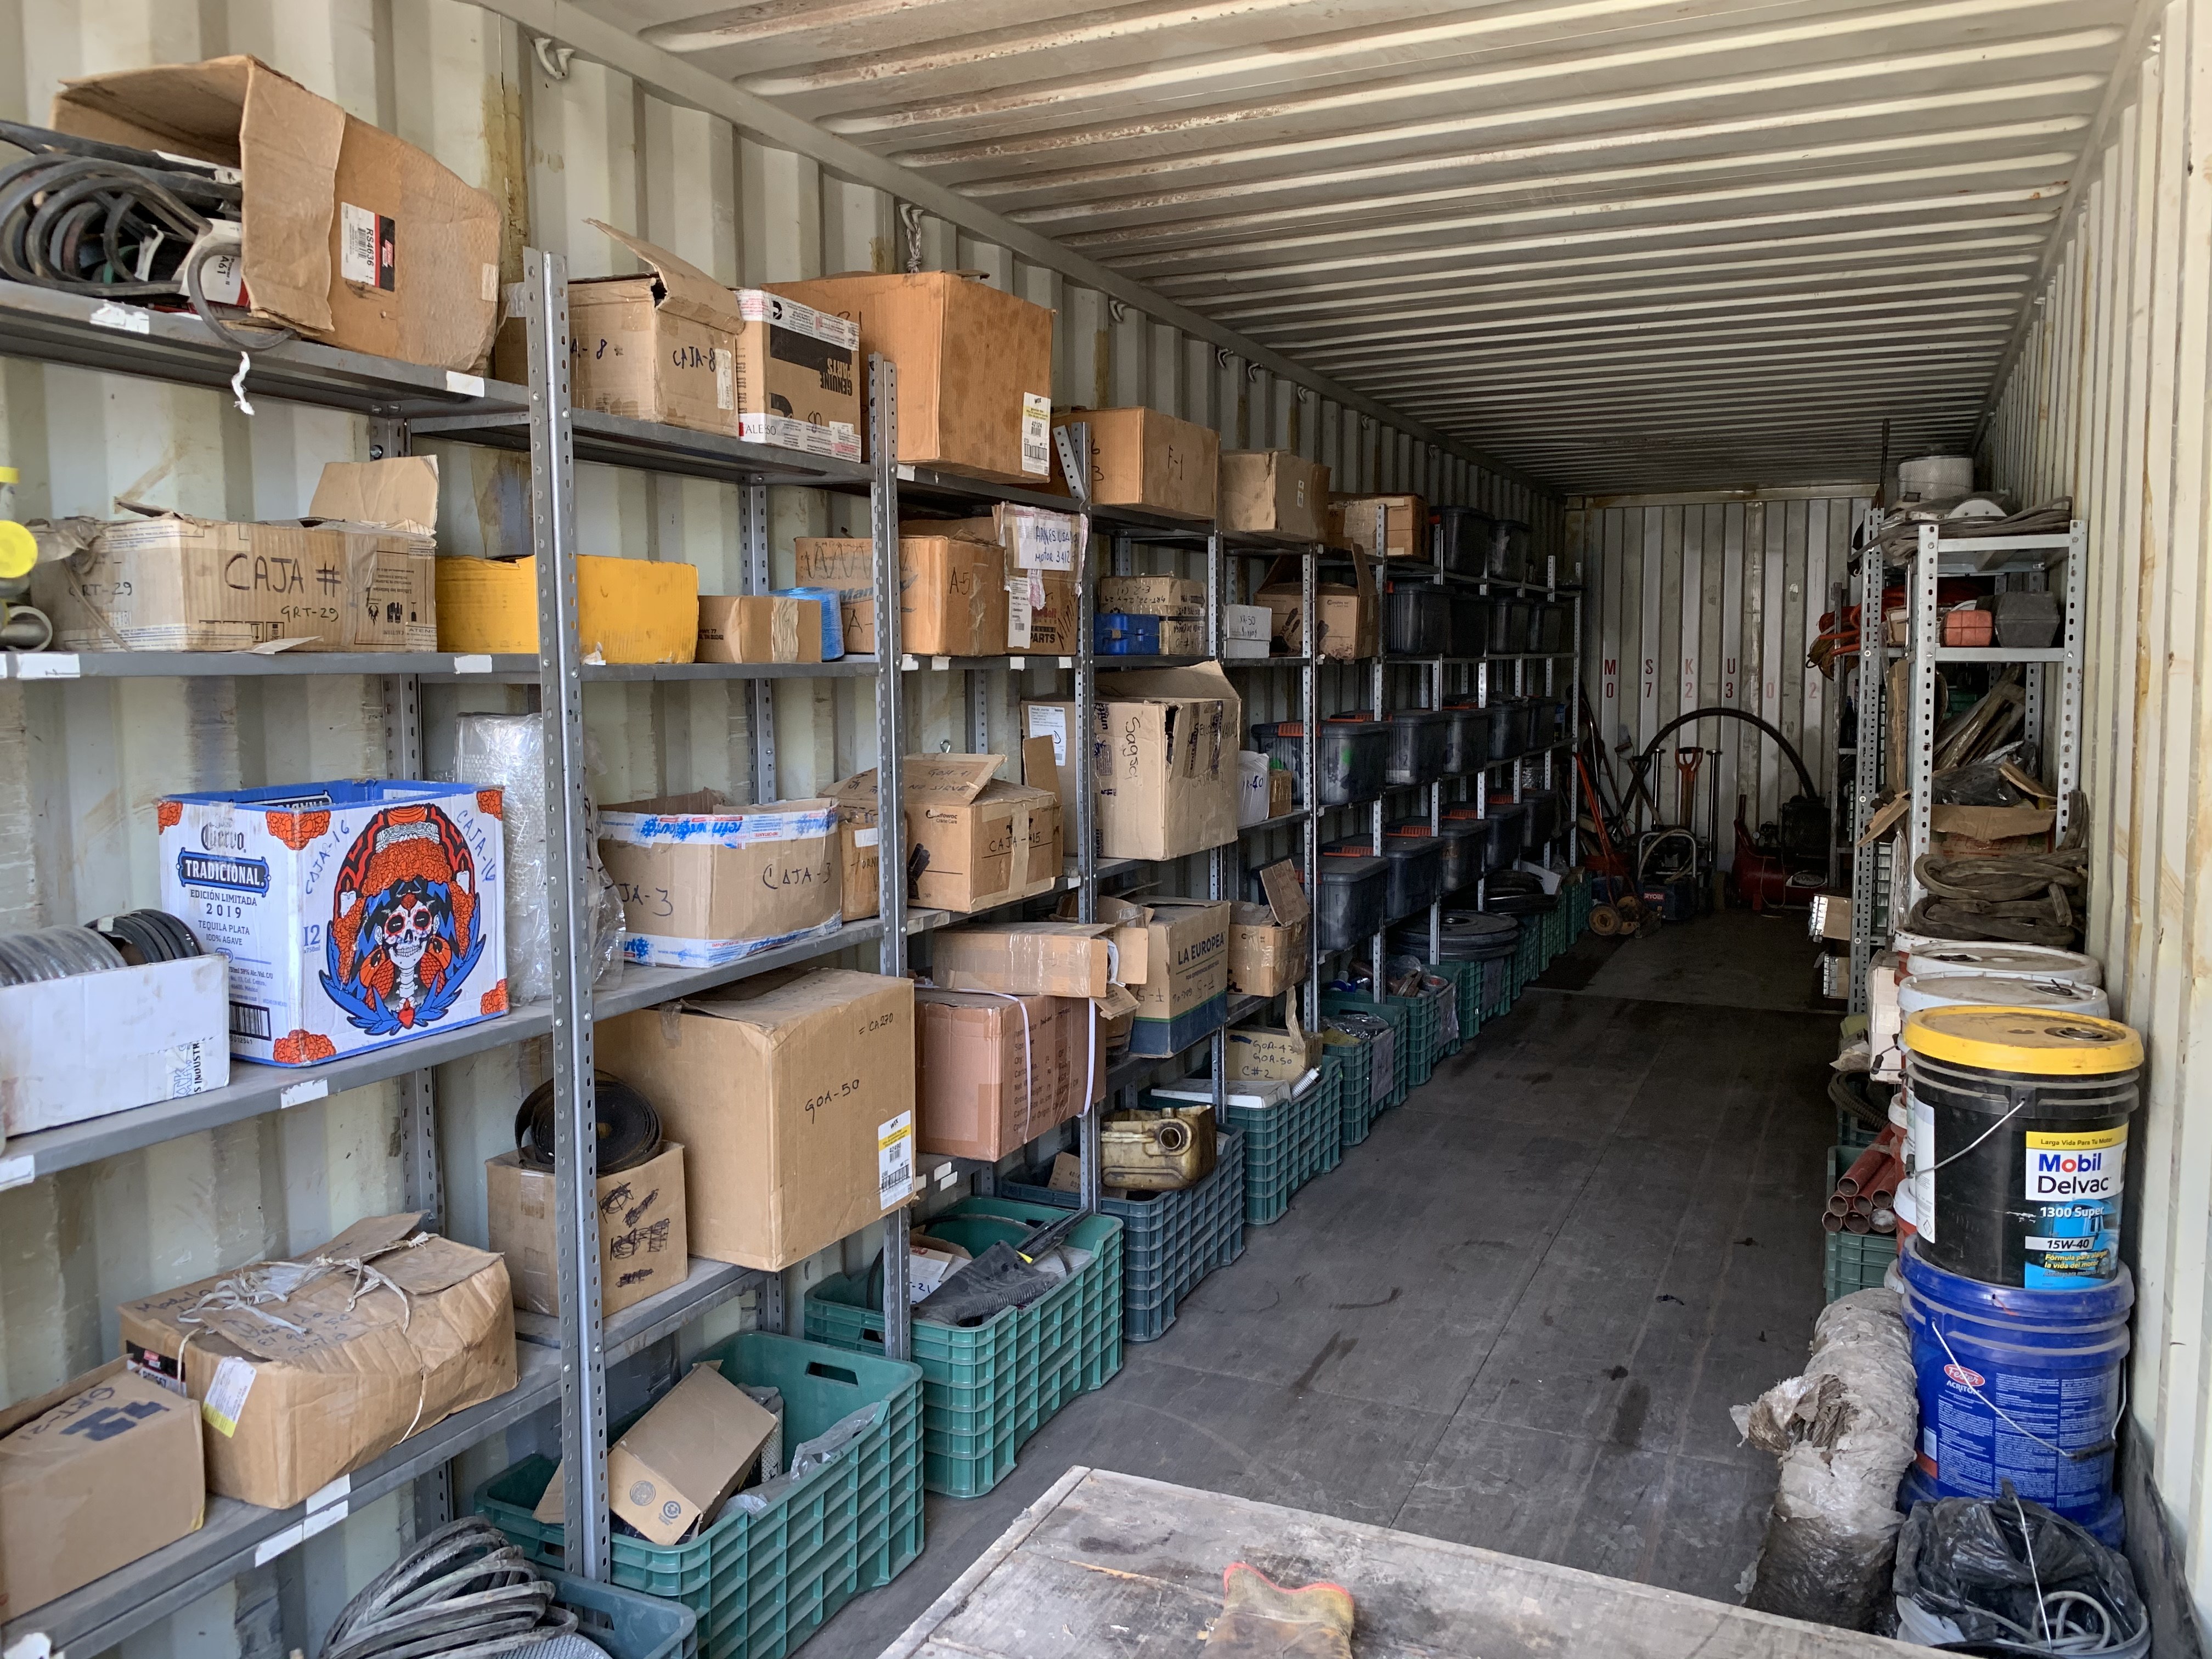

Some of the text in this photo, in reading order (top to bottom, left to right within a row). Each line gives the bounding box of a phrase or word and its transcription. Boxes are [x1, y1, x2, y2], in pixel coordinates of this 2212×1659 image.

[217, 256, 229, 274] A61
[673, 346, 716, 372] CAJA-8
[827, 358, 851, 380] PARTS
[820, 371, 853, 396] GENUINE
[224, 553, 341, 597] CAJA #
[950, 567, 970, 595] A-5
[281, 606, 339, 622] GRT-29
[1030, 633, 1056, 644] PARTS
[190, 889, 257, 906] EDICIÓN LIMITADA
[198, 920, 250, 935] TEQUILA PLATA
[303, 924, 321, 946] 12
[206, 933, 242, 945] 100% AGAVE
[1178, 932, 1224, 965] LA EUROPEA
[869, 1013, 894, 1031] CA270
[805, 1079, 860, 1124] GOA-50
[889, 1142, 901, 1153] 42490
[2039, 1153, 2102, 1172] Mobil
[2038, 1176, 2109, 1194] Delvac
[2040, 1206, 2104, 1218] 1300 Super
[2047, 1239, 2090, 1249] 15W-40
